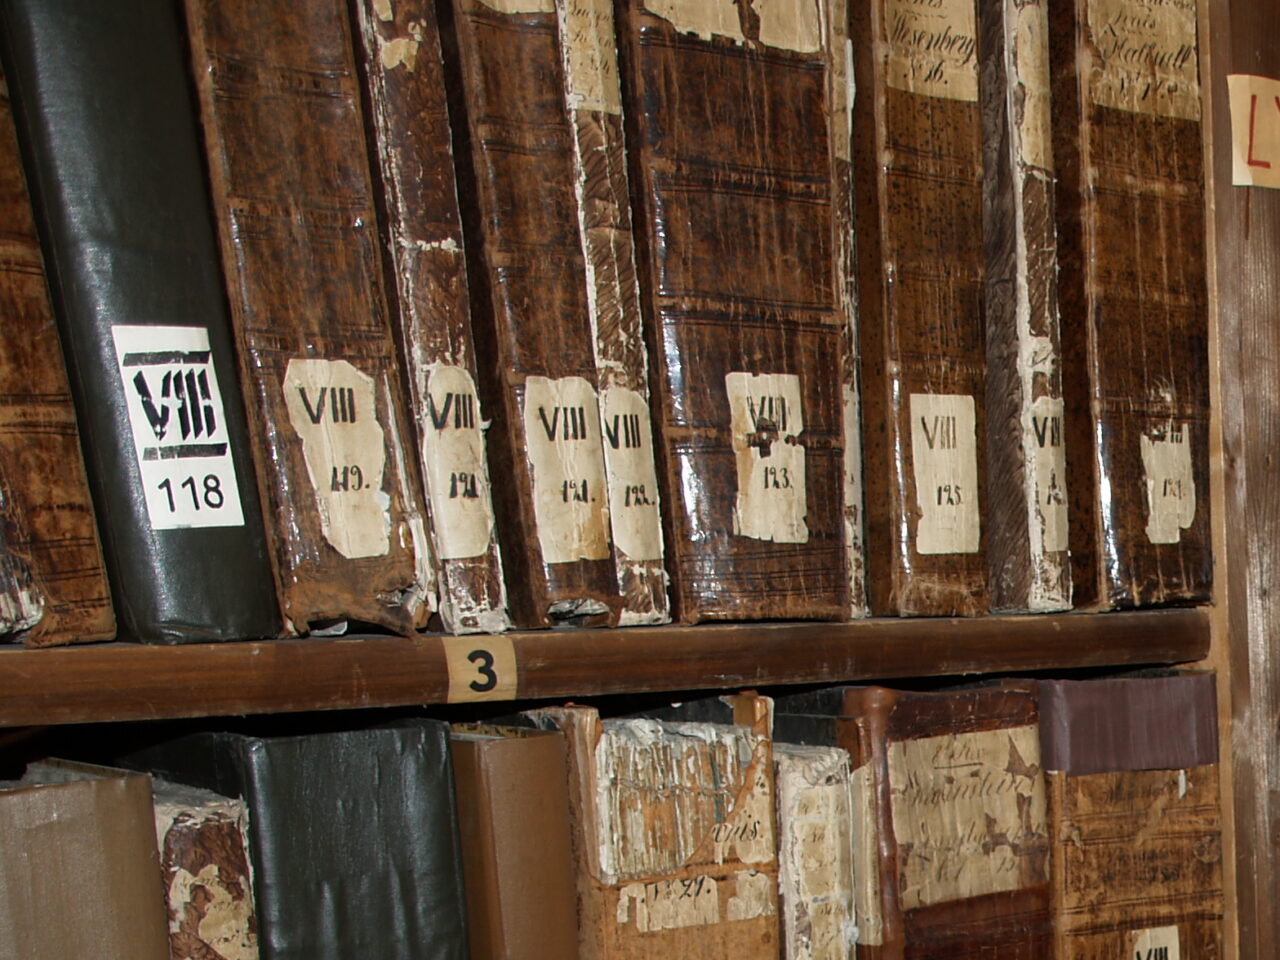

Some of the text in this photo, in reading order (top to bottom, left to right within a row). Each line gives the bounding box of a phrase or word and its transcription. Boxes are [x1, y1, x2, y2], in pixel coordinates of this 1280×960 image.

[128, 358, 223, 451] VIII
[298, 386, 356, 425] VIII
[428, 392, 474, 429] VIII
[538, 406, 587, 442] VIII
[604, 414, 641, 450] VIII
[921, 415, 957, 450] VIII
[157, 473, 224, 514] 118
[467, 649, 499, 693] 3
